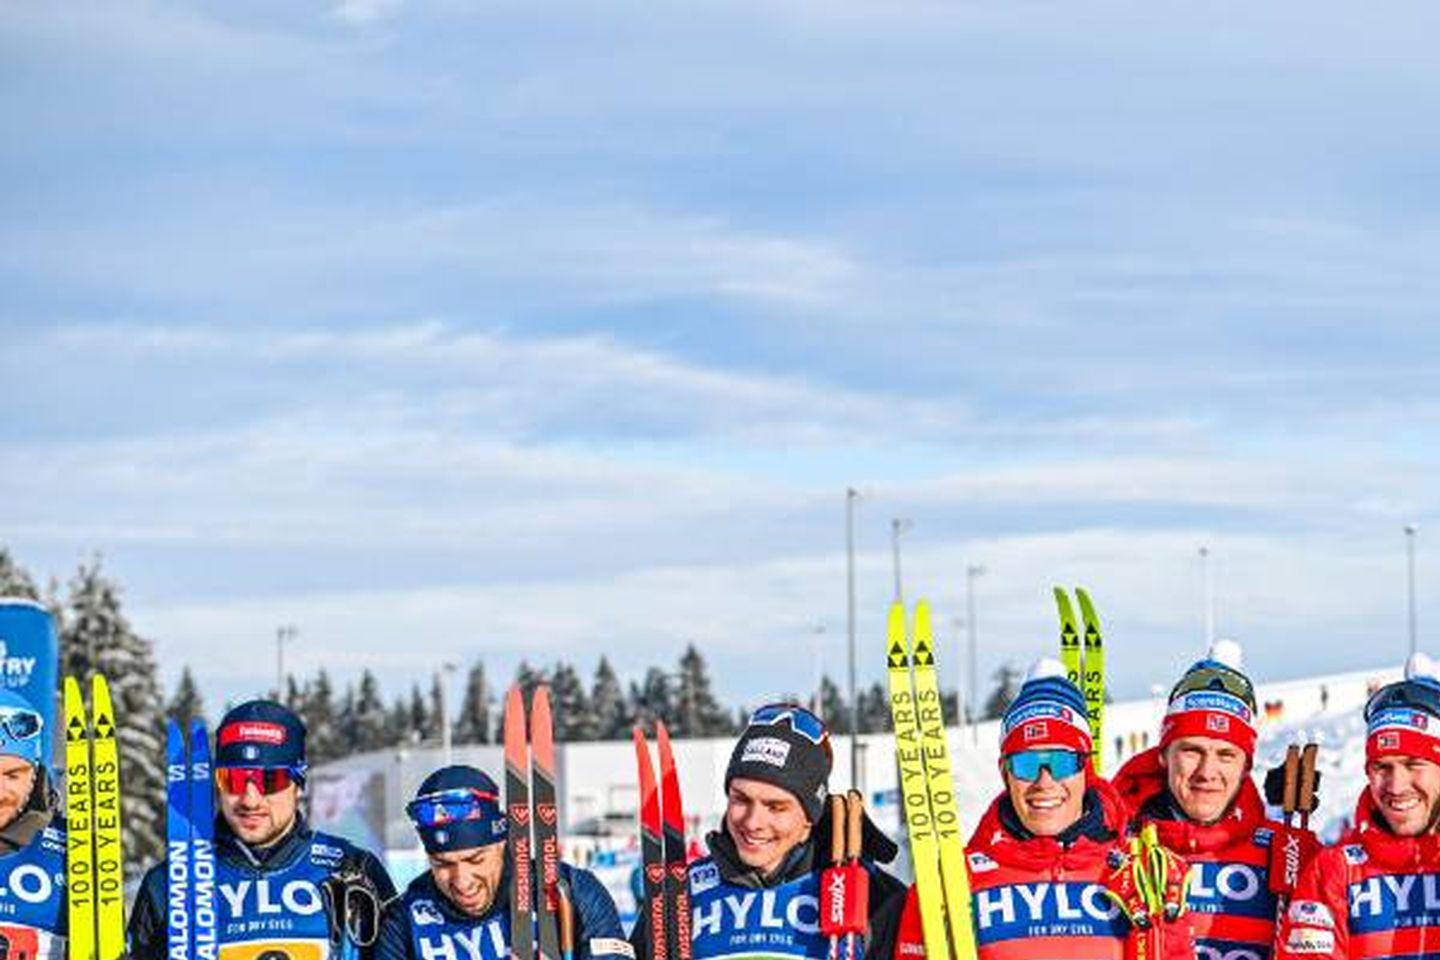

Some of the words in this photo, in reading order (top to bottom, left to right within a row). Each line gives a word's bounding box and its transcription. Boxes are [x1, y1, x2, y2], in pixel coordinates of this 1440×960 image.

[891, 690, 921, 785] YEARS
[918, 689, 951, 779] YEARS
[69, 763, 89, 850] YEARS
[97, 761, 117, 849] YEARS
[906, 794, 932, 841] 100
[934, 789, 957, 839] 100
[71, 862, 91, 908] 100
[100, 862, 120, 908] 100
[219, 880, 323, 917] YLO
[1190, 862, 1259, 900] LO
[978, 883, 1122, 929] HYLO
